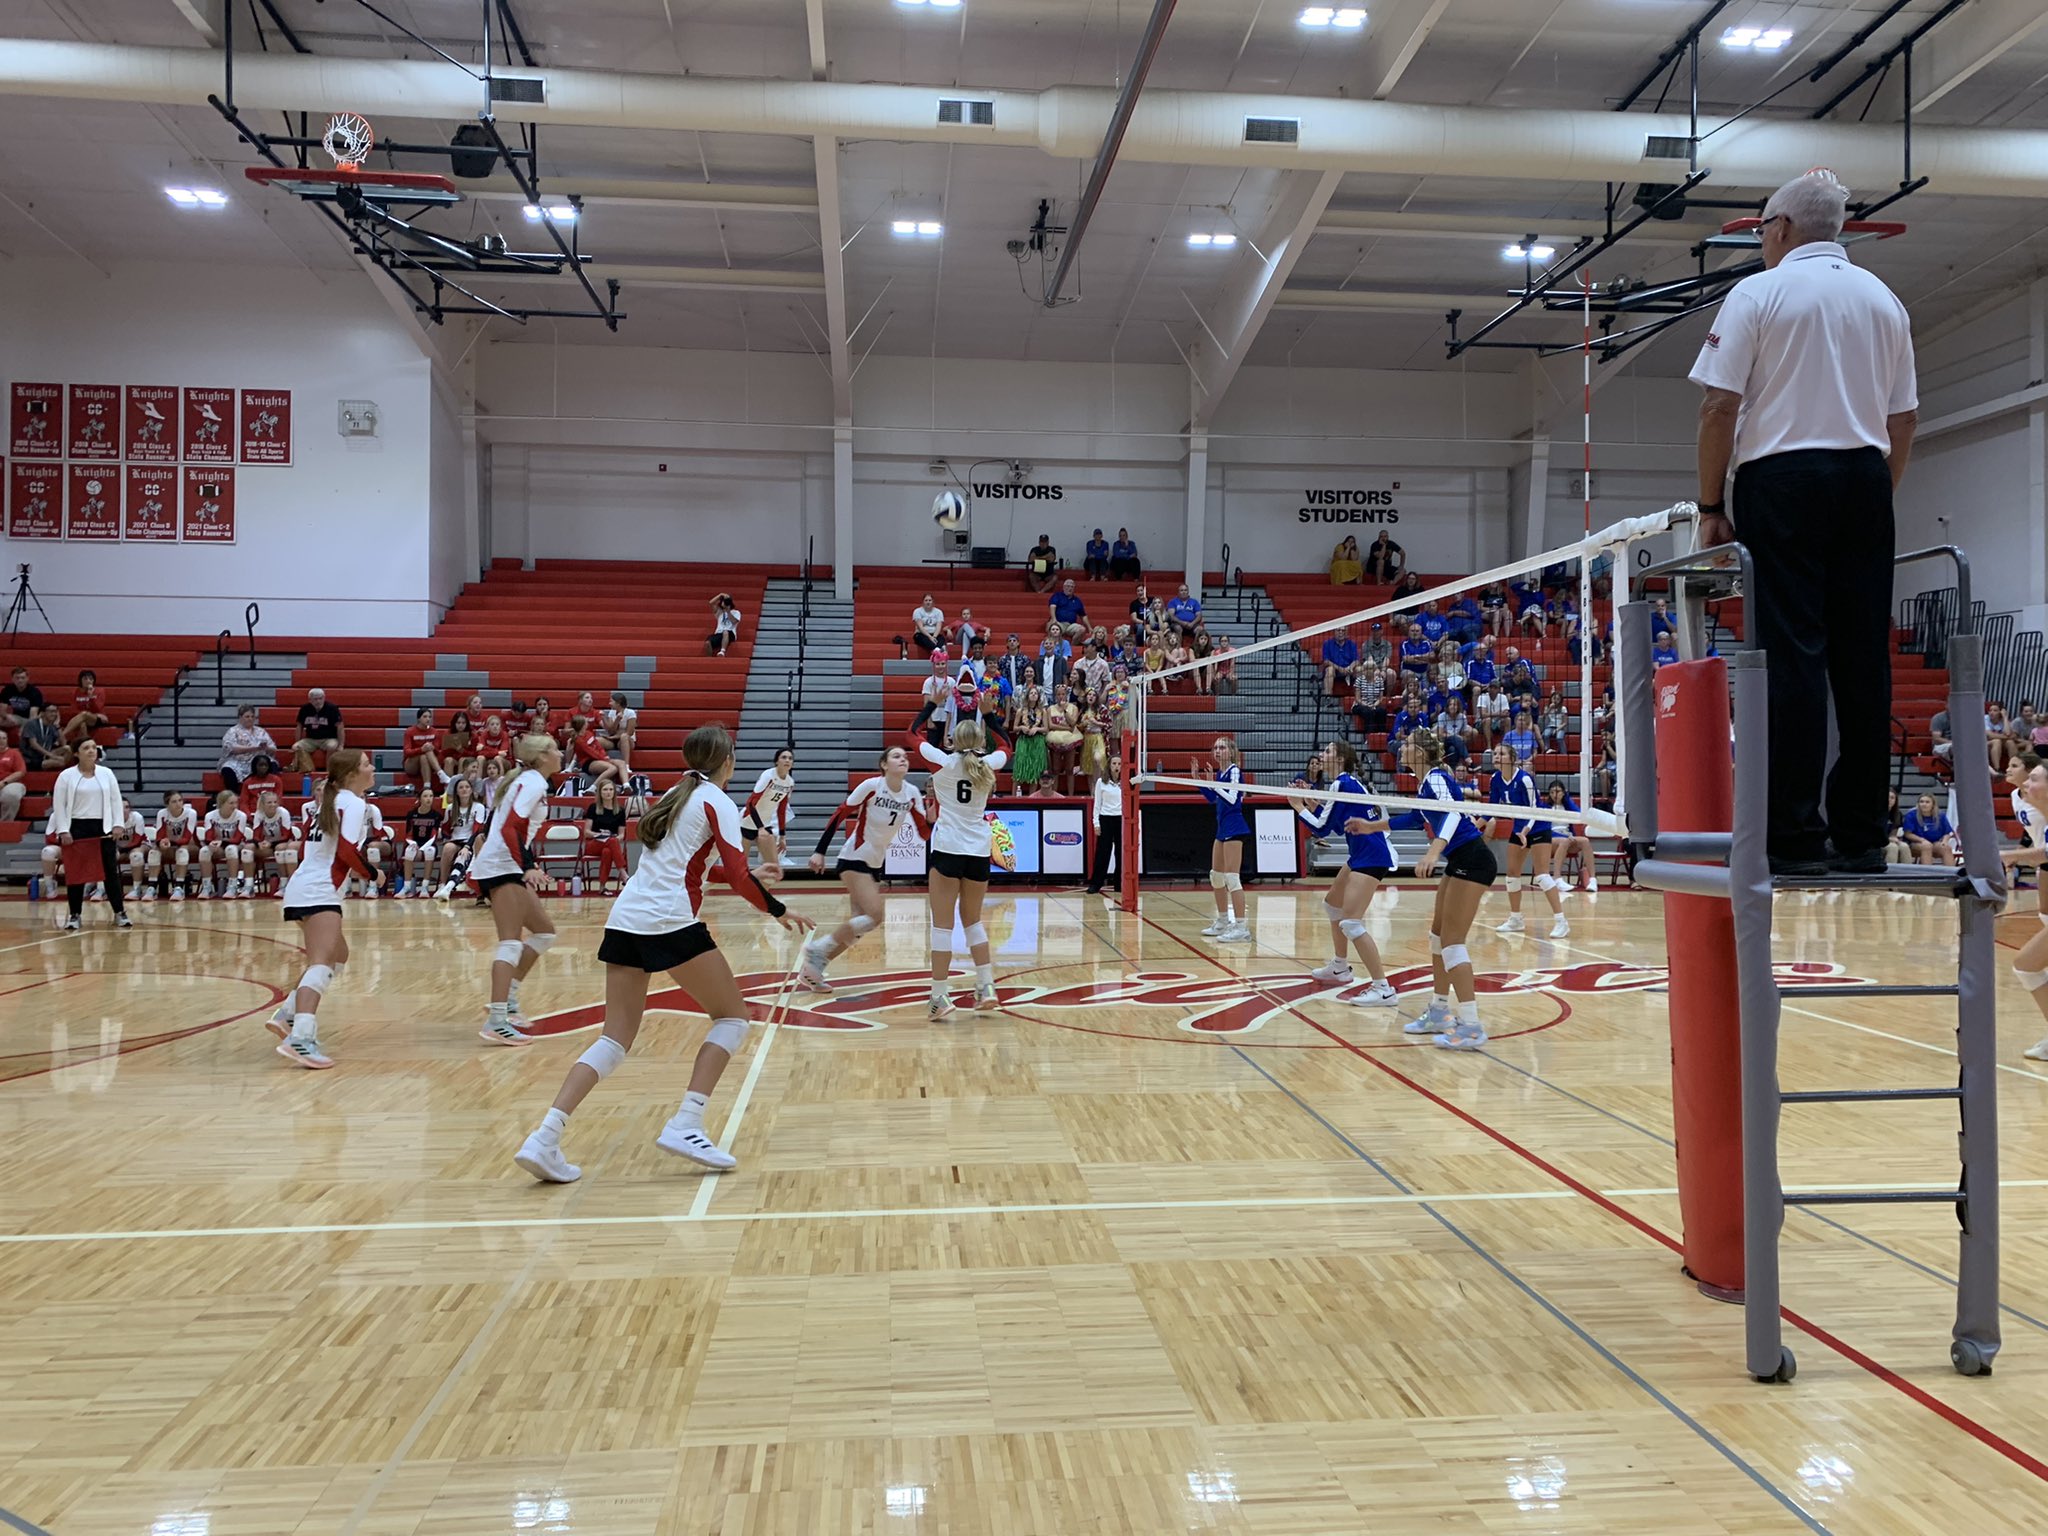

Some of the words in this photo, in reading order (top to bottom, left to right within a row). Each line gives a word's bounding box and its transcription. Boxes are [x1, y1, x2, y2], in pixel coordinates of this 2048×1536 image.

[17, 386, 57, 398] Knights
[75, 388, 115, 400] Knights
[132, 388, 173, 400] Knights
[190, 391, 229, 402] Knights
[246, 395, 287, 407] Knights
[16, 466, 58, 478] Knights
[74, 466, 115, 479] Knights
[132, 469, 172, 480] Knights
[190, 471, 229, 482] Knights
[145, 484, 159, 495] CC
[973, 483, 1063, 500] VISITORS
[1305, 489, 1393, 505] VISITORS
[1298, 508, 1399, 524] STUDENTS
[771, 792, 783, 802] 15
[956, 779, 972, 803] 6
[888, 811, 898, 826] 7
[891, 849, 920, 857] BANK
